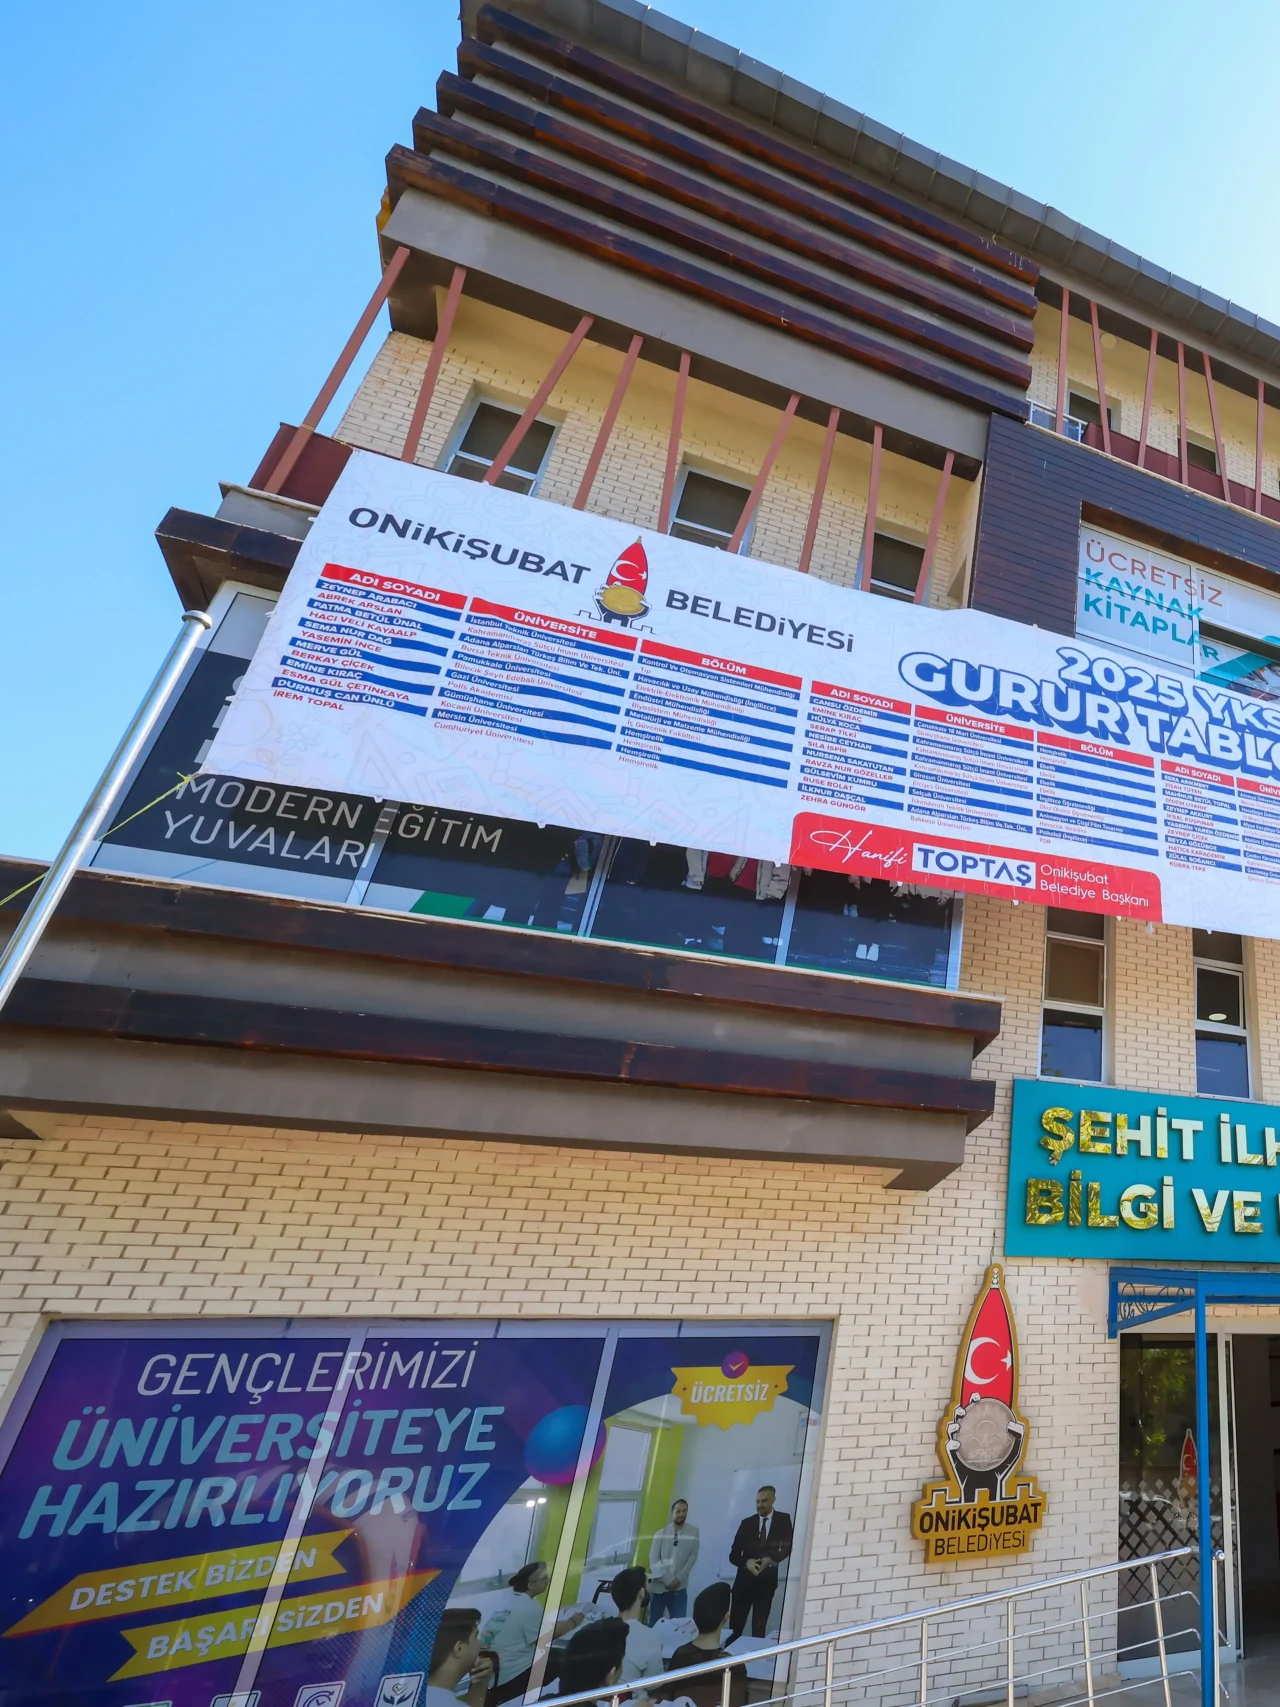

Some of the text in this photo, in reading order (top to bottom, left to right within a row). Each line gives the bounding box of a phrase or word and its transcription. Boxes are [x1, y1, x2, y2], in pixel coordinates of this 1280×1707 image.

[1086, 539, 1222, 607] ÜCRETSİZ
[321, 583, 417, 608] ZEYNEP ARABACI
[349, 573, 440, 601] ADI SOYADI
[1085, 567, 1203, 621] KAYNAK
[314, 602, 422, 629] FATMA BETÜL ÜNAL
[317, 592, 402, 614] ABREK ARSLAN
[304, 621, 392, 644] SEMA NUR DAĞ
[309, 612, 417, 636] HACI VELİ KAYAALP
[514, 611, 597, 638] ÜNİVERSİTE
[1084, 593, 1220, 661] KİTAPLAR
[295, 640, 363, 657] MERVE GÜL
[302, 631, 382, 652] YASEMİN İNCE
[286, 660, 363, 679] EMİNE KIRAÇ
[291, 650, 374, 671] BERKAY ÇİÇEK
[701, 658, 746, 675] BÖLÜM
[282, 669, 409, 700] ESMA GÜL ÇETİNKAYA
[1056, 647, 1187, 708] 2025
[273, 690, 344, 710] İREM TOPAL
[278, 679, 394, 707] DURMUŞ CAN ÜNLÜ
[830, 688, 893, 709] ADI SOYADI
[899, 652, 1129, 744] GURUR
[946, 714, 1005, 733] ÜNİVERSİTE
[1081, 744, 1113, 757] BÖLÜM
[1175, 766, 1220, 781] ADI SOYADI
[176, 774, 502, 852] MODERN EĞİTİM
[164, 811, 375, 868] YUVALARI
[810, 830, 1032, 886] Hanifi TOPTAŞ
[1040, 864, 1109, 885] Onikişubat
[1040, 880, 1149, 907] Belediye Başkanı
[1040, 1106, 1204, 1166] ŞEHİT
[1025, 1170, 1174, 1229] BİLGİ
[1192, 1188, 1264, 1233] VE
[138, 1341, 478, 1404] GENÇLERİMİZİ
[691, 1380, 769, 1404] ÜCRETSİZ
[52, 1399, 505, 1471] ÜNİVERSİTEYE
[18, 1463, 491, 1539] HAZIRLIYORUZ
[69, 1568, 198, 1611] DESTEK
[147, 1614, 267, 1656] BAŞARI
